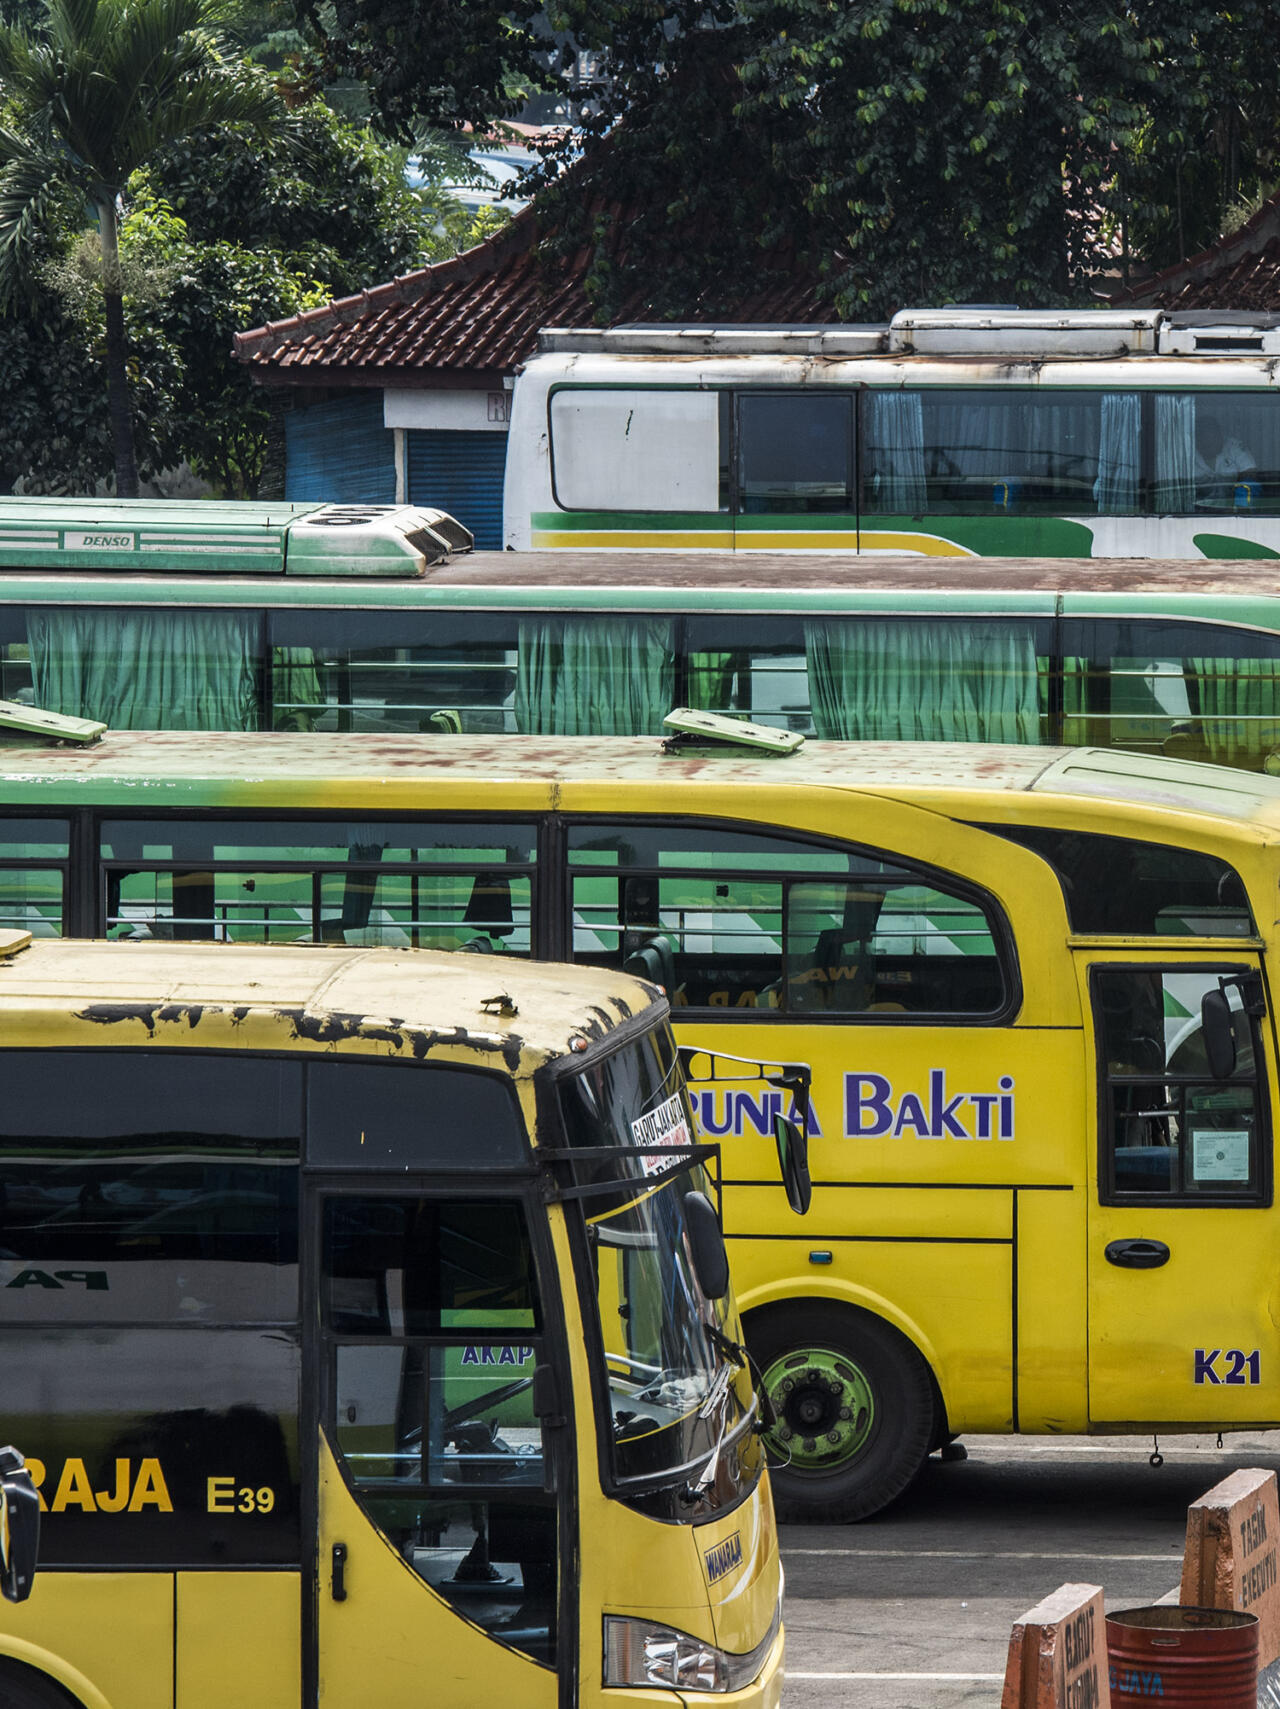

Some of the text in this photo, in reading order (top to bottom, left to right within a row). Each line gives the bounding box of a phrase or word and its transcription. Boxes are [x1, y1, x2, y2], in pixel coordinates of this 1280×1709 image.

[83, 536, 130, 546] DENSO
[461, 1346, 535, 1366] AKAP
[207, 1477, 275, 1513] E39
[1240, 1503, 1268, 1558] TASIK
[705, 1534, 742, 1582] WANARAJA
[1065, 1606, 1095, 1672] GARUT
[1119, 1671, 1164, 1696] JAYA
